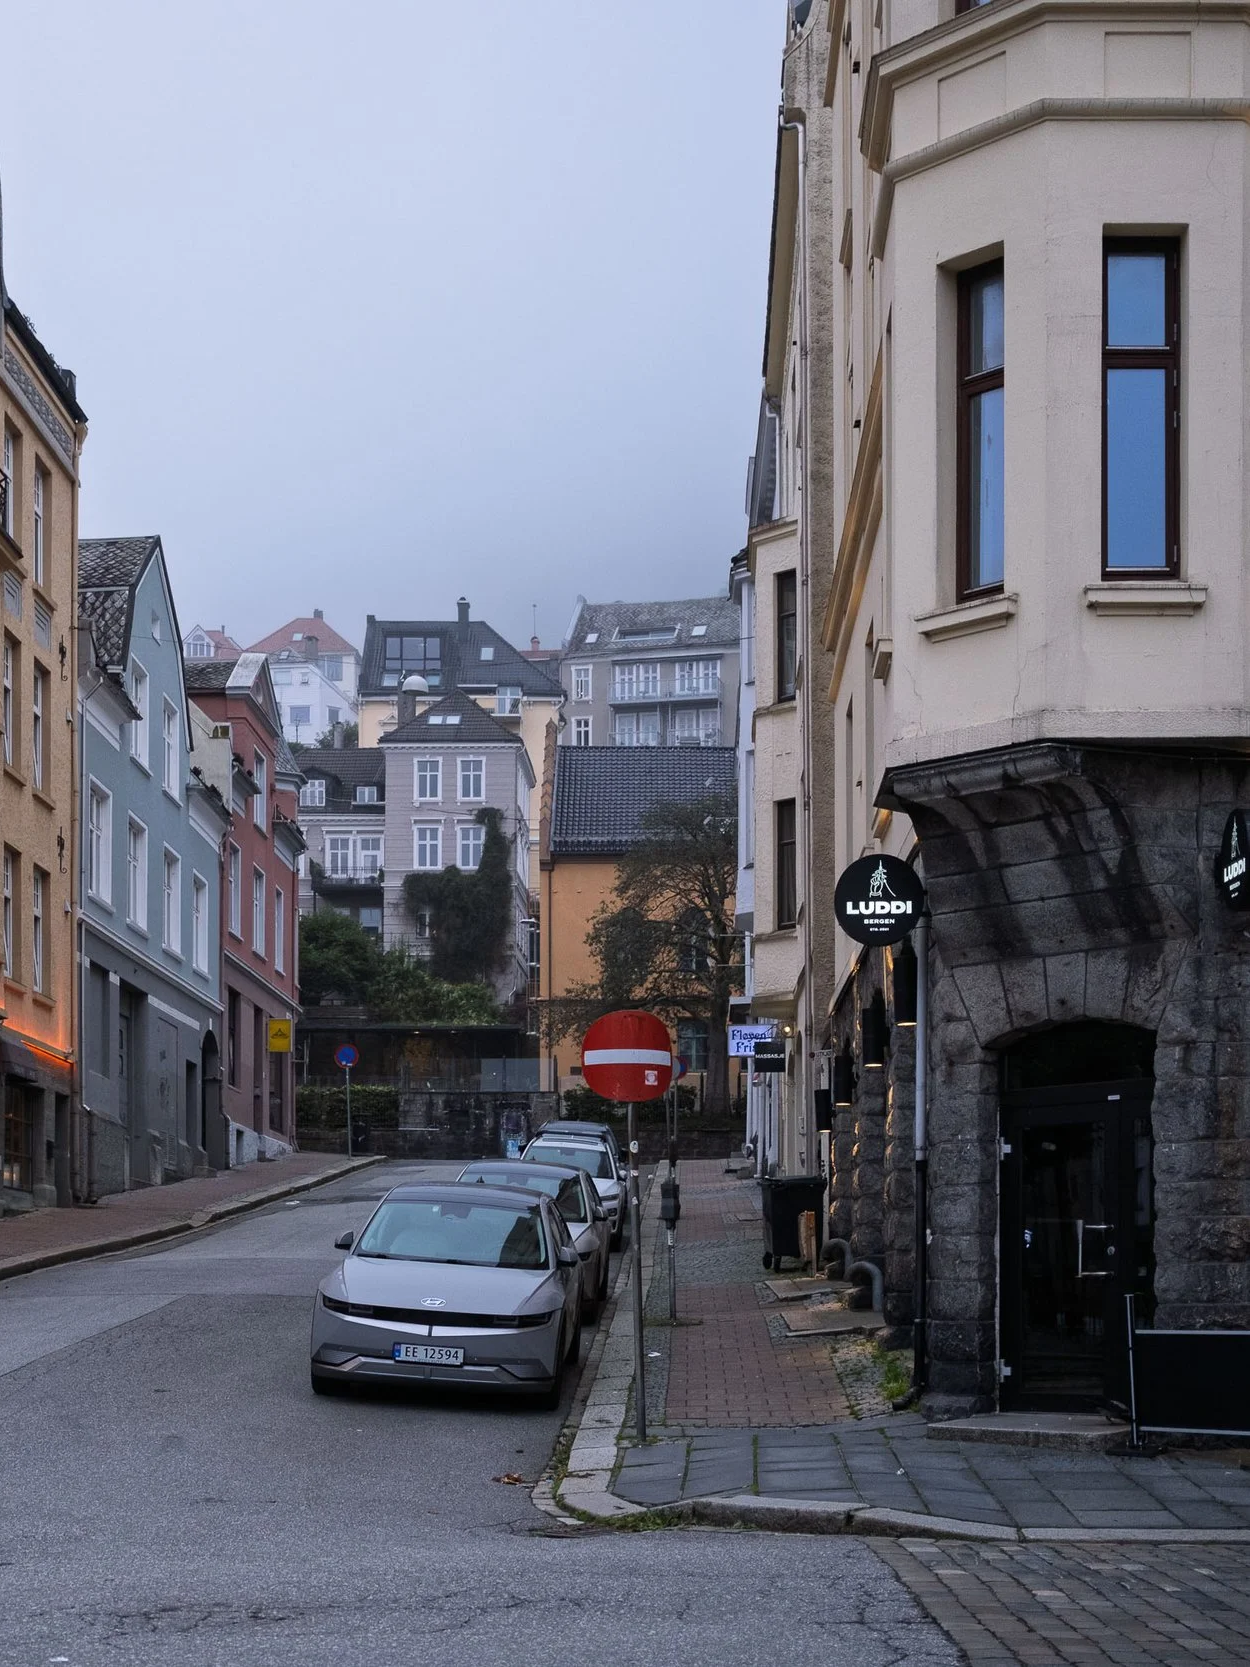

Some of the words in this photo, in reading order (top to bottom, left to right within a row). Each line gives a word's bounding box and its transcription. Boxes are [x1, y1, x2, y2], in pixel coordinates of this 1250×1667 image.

[1223, 857, 1246, 883] LUDDI
[846, 900, 913, 915] LUDDI
[731, 1029, 767, 1042] Fløyen
[405, 1346, 418, 1358] EE
[423, 1348, 459, 1361] 12594
